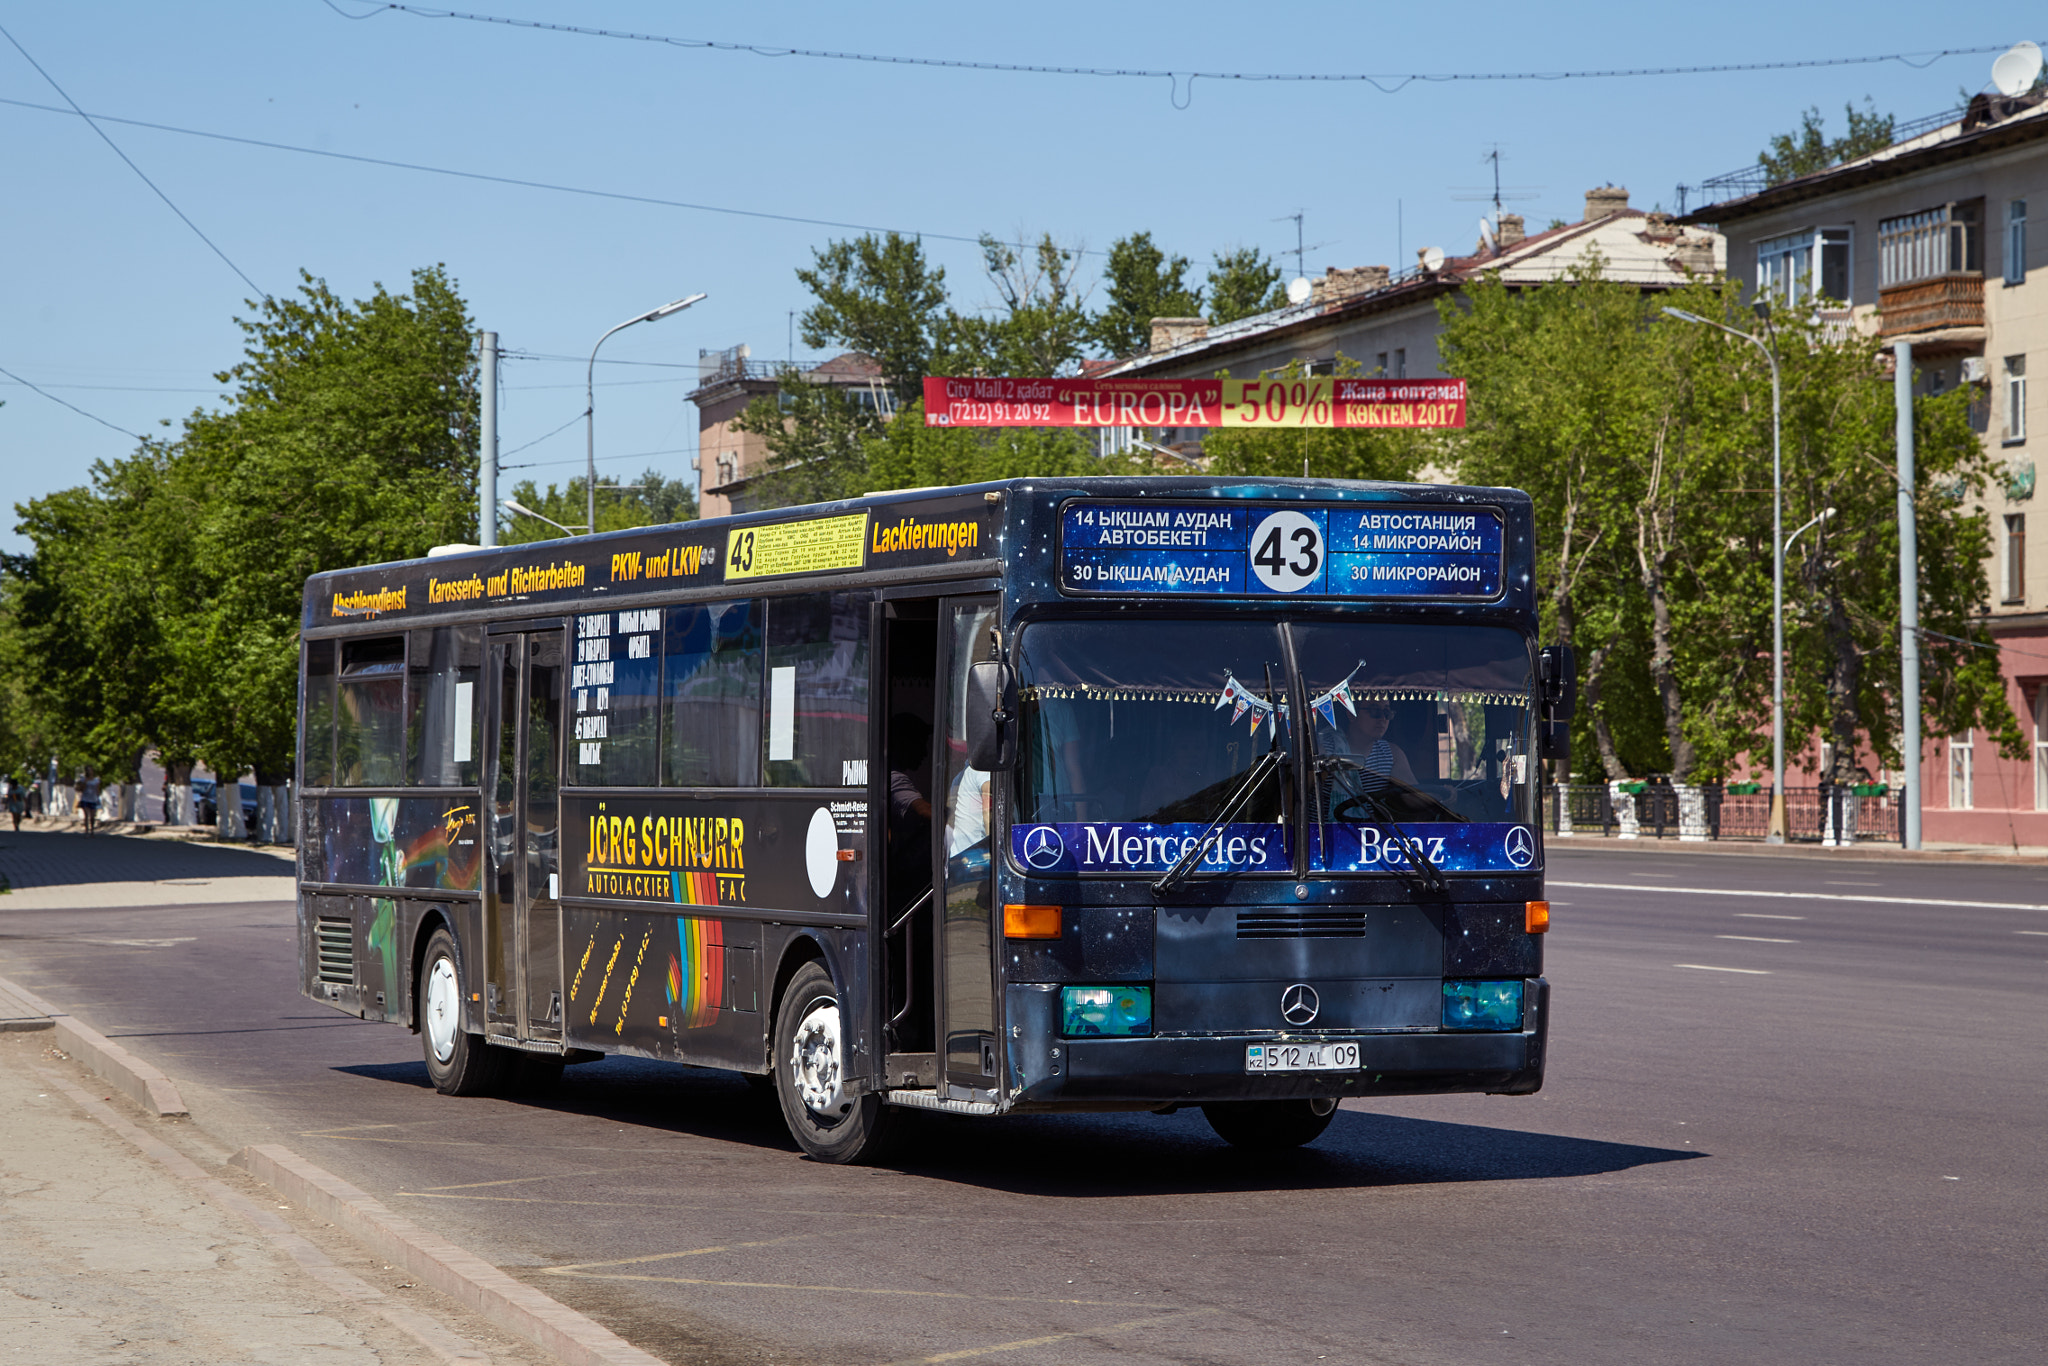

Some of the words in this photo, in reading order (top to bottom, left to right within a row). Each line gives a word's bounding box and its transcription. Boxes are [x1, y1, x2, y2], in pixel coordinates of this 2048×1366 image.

[946, 381, 971, 402] City
[1017, 381, 1054, 402] қабат
[1340, 382, 1386, 403] Жаңа
[1391, 381, 1464, 401] топтама!
[950, 402, 992, 424] (7212)
[994, 403, 1011, 422] 91
[1013, 403, 1031, 421] 20
[1033, 403, 1051, 421] 92
[1225, 381, 1328, 425] -50%
[1346, 404, 1415, 425] КӨКТЕМ
[1417, 403, 1458, 425] 2017
[1075, 511, 1094, 528] 14
[1099, 512, 1169, 532] ЫҚШАМ
[1174, 513, 1232, 530] АУДАН
[1358, 515, 1476, 532] АВТОСТАНЦИЯ
[872, 518, 978, 557] Lackierungen
[1099, 530, 1207, 546] АВТОБЕКЕТІ
[1352, 535, 1370, 550] 14
[1374, 533, 1482, 551] МИКРОРАЙОН
[731, 531, 754, 573] 43
[1254, 527, 1319, 577] 43
[611, 552, 642, 581] PKW-
[646, 548, 668, 578] und
[672, 546, 702, 577] LKW
[1351, 566, 1369, 581] 30
[1372, 564, 1481, 582] МИКРОРАЙОН
[429, 577, 484, 603] Karosserie-
[487, 569, 508, 596] und
[511, 562, 585, 594] Richtarbeiten
[1073, 565, 1092, 582] 30
[1097, 566, 1168, 585] ЫҚШАМ
[1173, 567, 1230, 584] АУДАН
[332, 585, 406, 620] Abschleppdienst
[578, 616, 586, 638] 32
[587, 802, 636, 865] JÖRG
[641, 815, 744, 869] SCHNURR
[1082, 826, 1267, 865] Mercedes
[1358, 826, 1444, 864] Benz
[587, 874, 669, 898] AUTOLACKIER
[1249, 1060, 1262, 1068] KZ
[1268, 1047, 1300, 1066] 512
[1307, 1052, 1326, 1067] AL
[1334, 1046, 1357, 1065] 09
